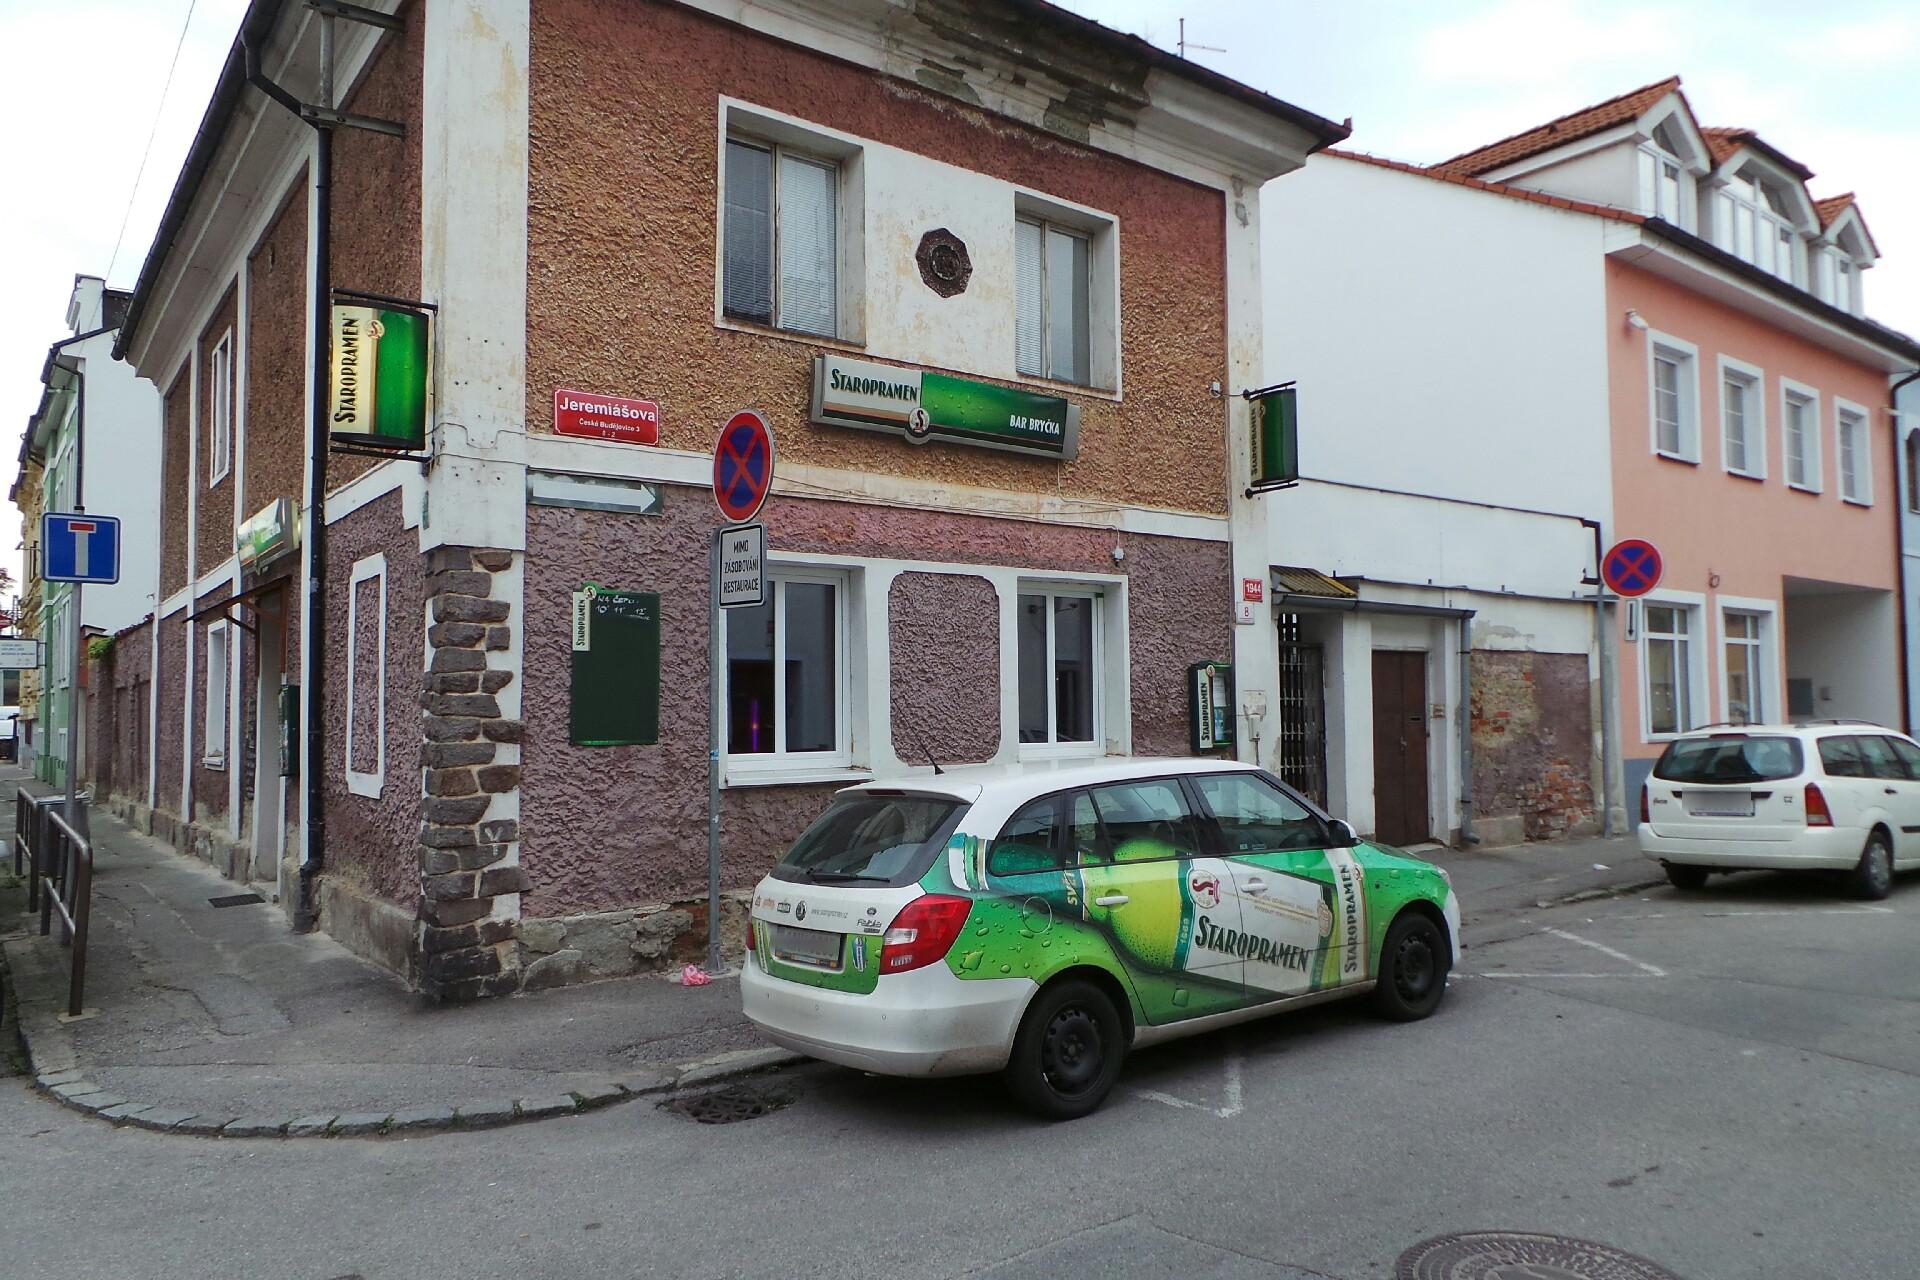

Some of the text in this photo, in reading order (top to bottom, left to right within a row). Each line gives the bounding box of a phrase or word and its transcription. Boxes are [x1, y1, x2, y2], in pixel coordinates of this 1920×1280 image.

[334, 318, 359, 424] STAROPRAMEN
[830, 367, 918, 403] STAROPRAMEN
[560, 397, 656, 422] Jeremiášova
[1010, 414, 1027, 429] BAR
[724, 555, 759, 574] ZÁSOBOVÁNÍ
[733, 539, 749, 554] MIMO
[723, 578, 759, 593] RESTAURACE
[576, 600, 586, 646] STAROPRAMEN
[1201, 683, 1210, 741] STAROPRAMEN
[1339, 864, 1358, 974] STAROPRAMEN
[1195, 915, 1311, 973] STAROPRAMEN
